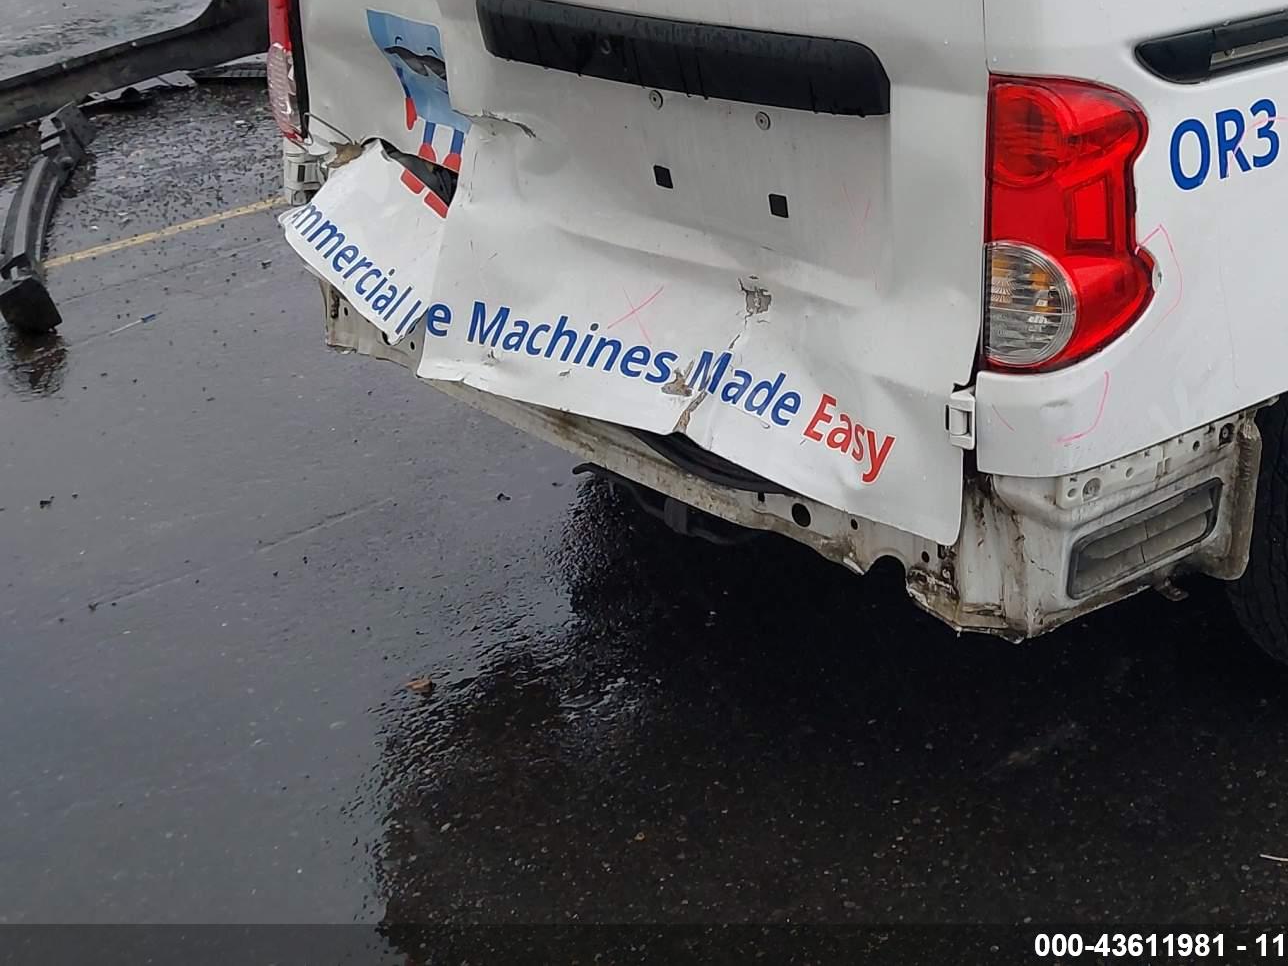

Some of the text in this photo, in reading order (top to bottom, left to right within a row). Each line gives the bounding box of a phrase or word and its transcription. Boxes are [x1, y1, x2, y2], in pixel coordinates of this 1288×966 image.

[1170, 99, 1280, 191] OR3
[467, 301, 679, 384] Machines
[688, 350, 801, 426] Made
[803, 393, 896, 483] Easy
